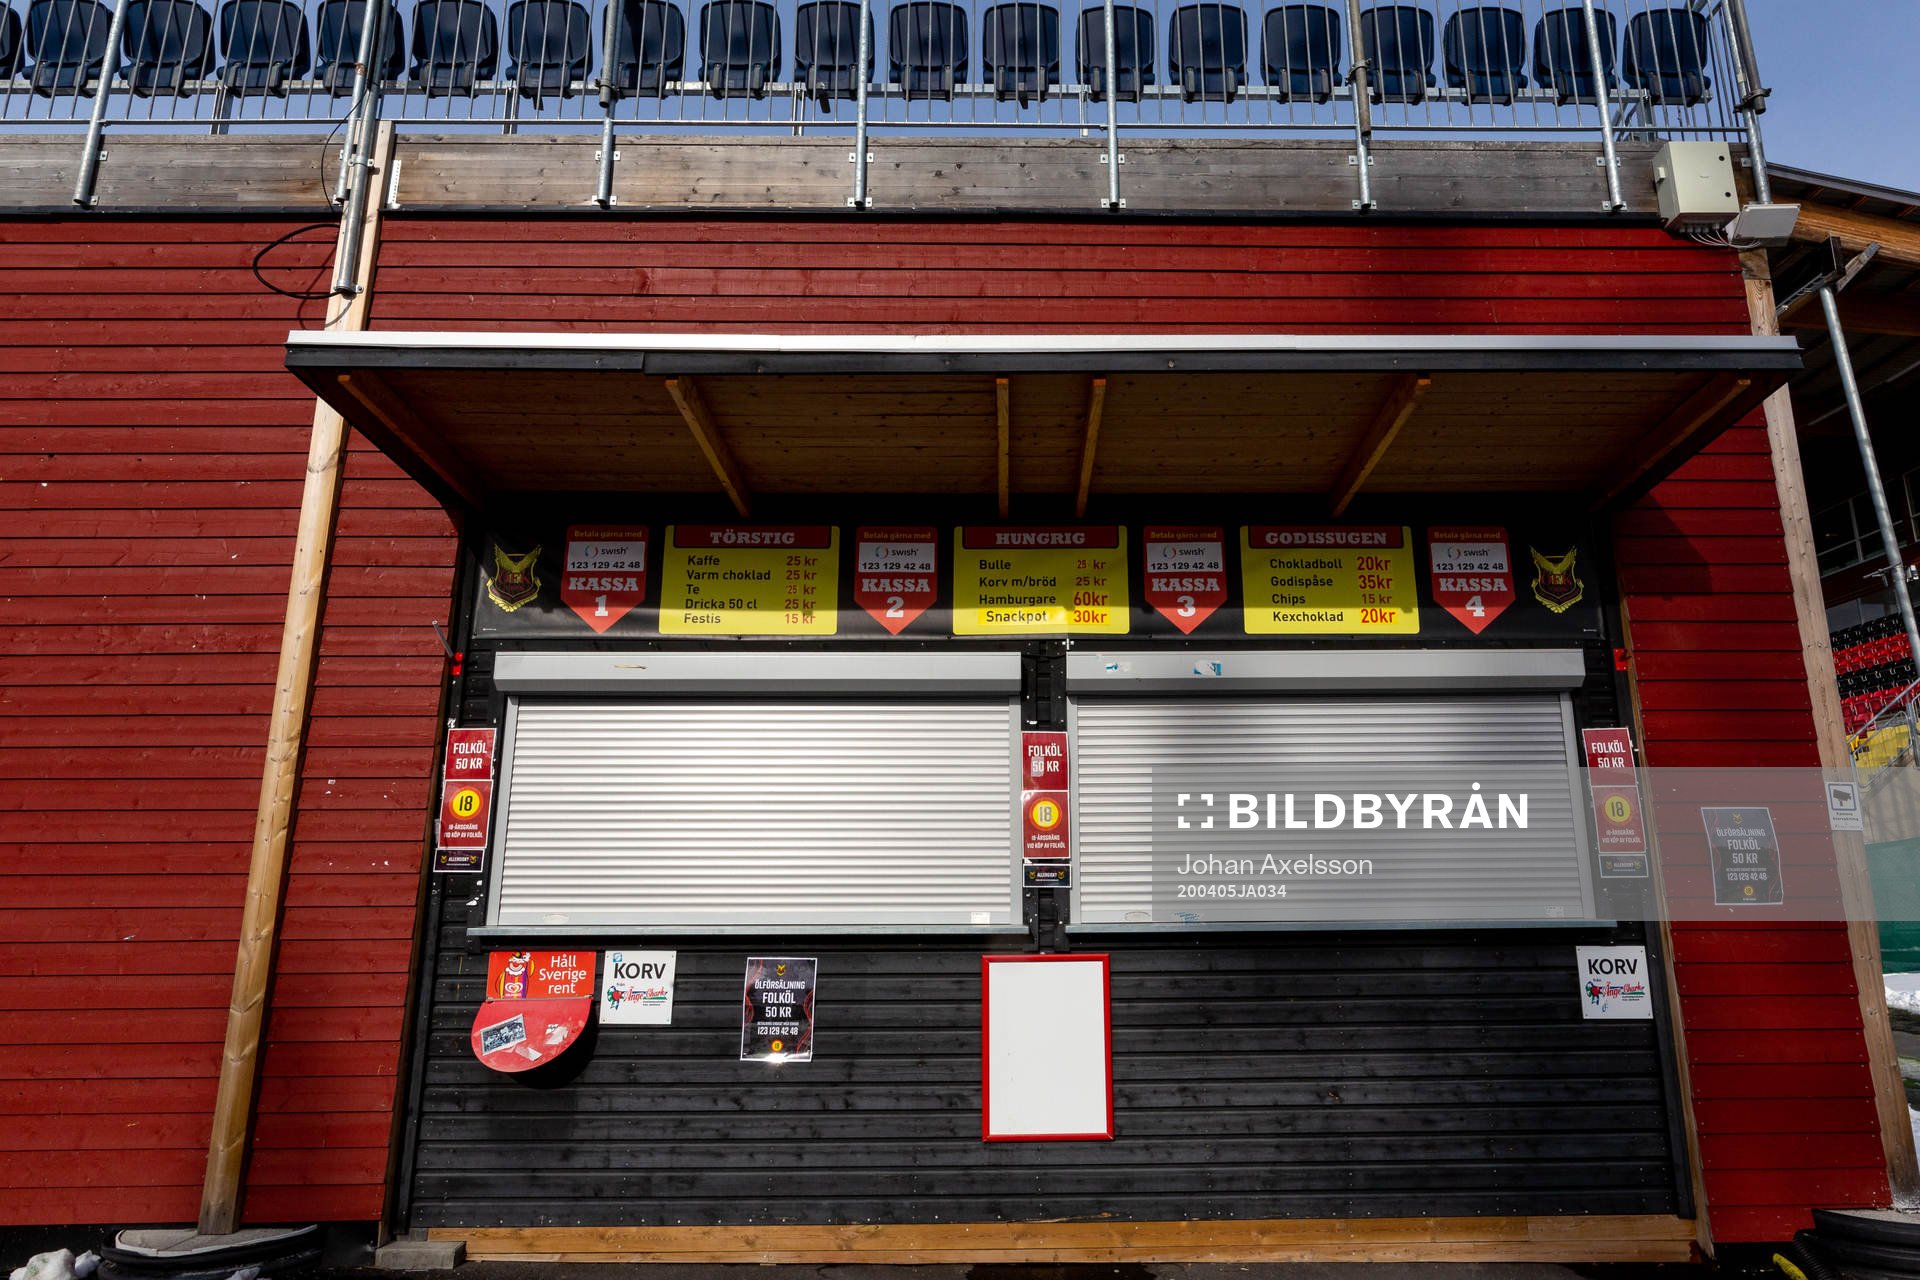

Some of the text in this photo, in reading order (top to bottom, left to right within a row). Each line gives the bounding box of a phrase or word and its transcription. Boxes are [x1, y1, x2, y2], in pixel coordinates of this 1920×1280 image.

[575, 530, 599, 538] Betala
[710, 529, 795, 544] TÖRSTIG
[996, 533, 1085, 545] HUNGRIG
[1265, 532, 1386, 544] GODISSUGEN
[601, 546, 626, 555] swish
[892, 548, 916, 556] swish
[1179, 548, 1203, 556] swish
[1464, 548, 1488, 556] swish
[571, 561, 640, 569] 123 129 42 48
[688, 555, 817, 566] Kaffe 25 kr
[980, 560, 1012, 570] Bulle
[1093, 560, 1106, 569] kr
[1151, 562, 1219, 570] 123 129 42 48
[1270, 557, 1391, 571] Chokladboll 20kr
[687, 570, 816, 580] Varm choklad 25 kr
[569, 578, 638, 591] KASSA
[862, 579, 930, 592] KASSA
[980, 576, 1106, 587] Korv m/bröd 25 kr
[1152, 578, 1220, 592] KASSA
[1271, 575, 1392, 589] Godispåse 35kr
[1439, 578, 1508, 591] KASSA
[686, 584, 816, 594] Te 25 kr
[685, 599, 816, 609] Dricka 50 cl 25 kr
[980, 592, 1108, 606] Hamburgare 60kr
[1272, 594, 1392, 605] Chips 15 kr
[595, 595, 608, 616] 1
[886, 596, 904, 618] 2
[1177, 596, 1196, 617] 3
[1466, 596, 1485, 617] 4
[684, 613, 816, 624] Festis 15 kr
[986, 610, 1107, 624] Snackpot 30kr
[1273, 609, 1396, 623] Kexchoklad 20kr
[453, 740, 488, 754] FOLKÖL
[1028, 743, 1062, 757] FOLKÖL
[1592, 740, 1626, 754] FOLKÖL
[456, 758, 483, 769] 50 KR
[1032, 760, 1059, 772] 50 KR
[1597, 757, 1624, 769] 50 KR
[459, 795, 473, 811] 18
[1611, 801, 1624, 817] 18
[1039, 806, 1052, 822] 18
[1716, 827, 1766, 837] ÖLFÖRSÄLJNING
[1727, 838, 1760, 850] FOLKÖL
[1732, 853, 1758, 864] 50 KR
[1727, 873, 1767, 881] 123 129 42 48
[551, 954, 576, 967] Håll
[1588, 958, 1638, 975] KORV
[539, 968, 587, 983] Sverige
[614, 963, 666, 979] KORV
[548, 983, 575, 994] rent
[754, 979, 805, 990] ÖLFÖRSÄLJNING
[762, 990, 796, 1004] FOLKÖL
[765, 1007, 792, 1018] 50 KR
[757, 1026, 798, 1035] 123 129 42 48
